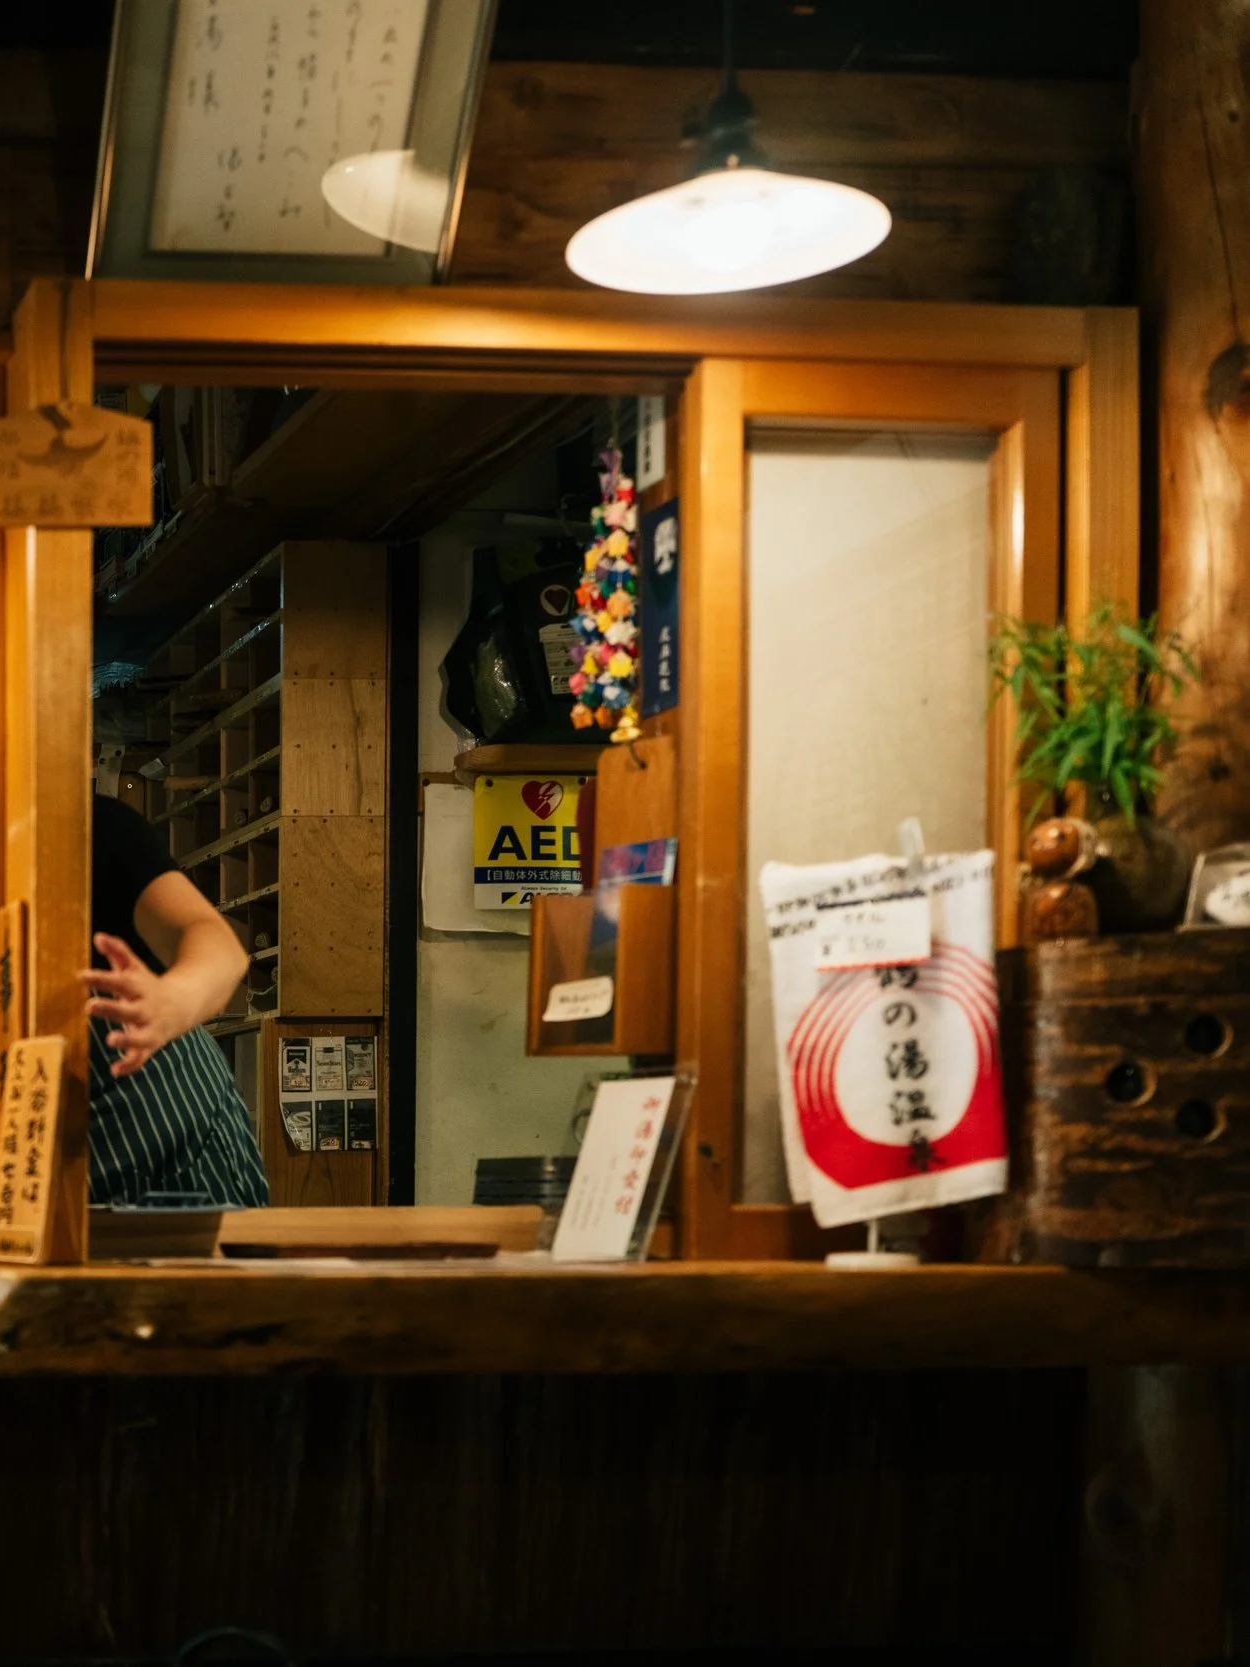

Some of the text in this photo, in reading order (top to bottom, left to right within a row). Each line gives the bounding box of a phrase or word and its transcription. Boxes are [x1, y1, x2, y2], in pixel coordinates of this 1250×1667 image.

[487, 825, 581, 861] AED
[486, 869, 582, 882] 【自動体外式除細動
